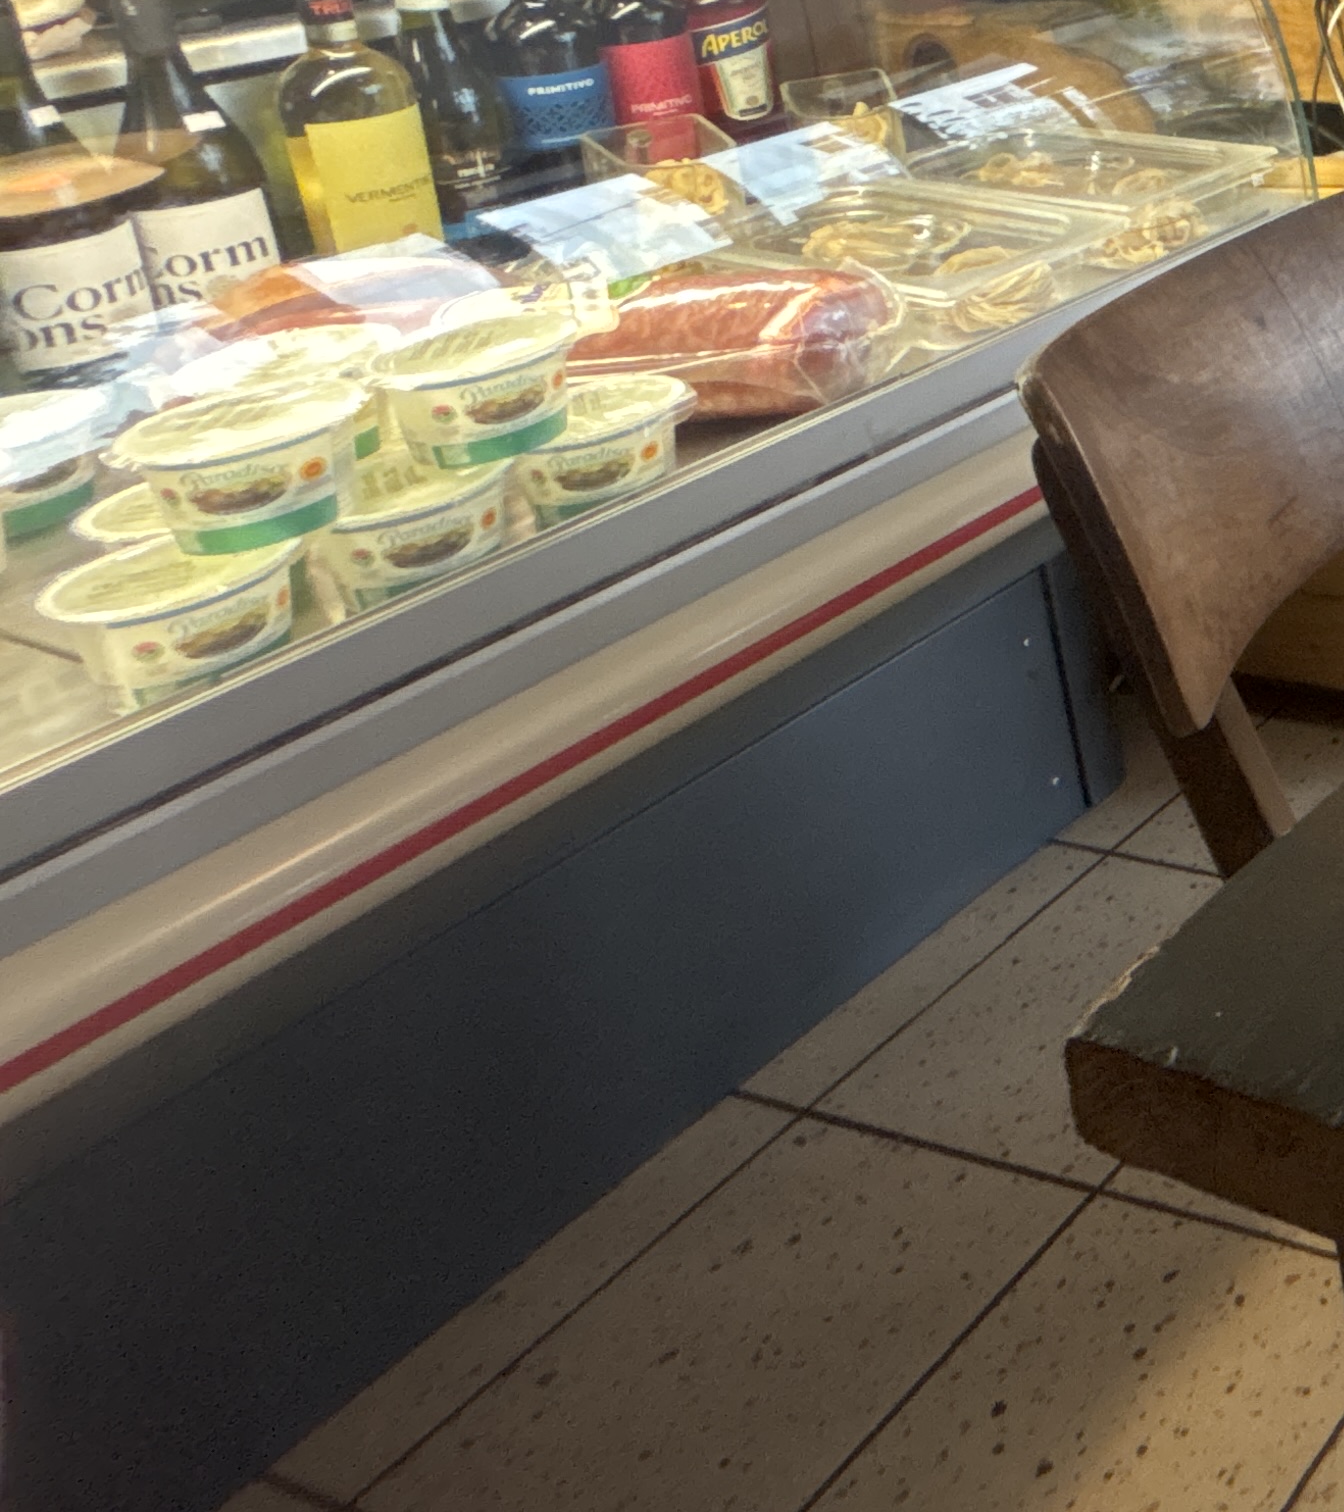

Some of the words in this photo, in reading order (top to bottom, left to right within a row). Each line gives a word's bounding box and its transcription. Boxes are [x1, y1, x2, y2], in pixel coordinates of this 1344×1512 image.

[527, 77, 595, 96] PRIMITIVO
[631, 94, 693, 114] PRIMITIVO
[152, 236, 269, 278] orm
